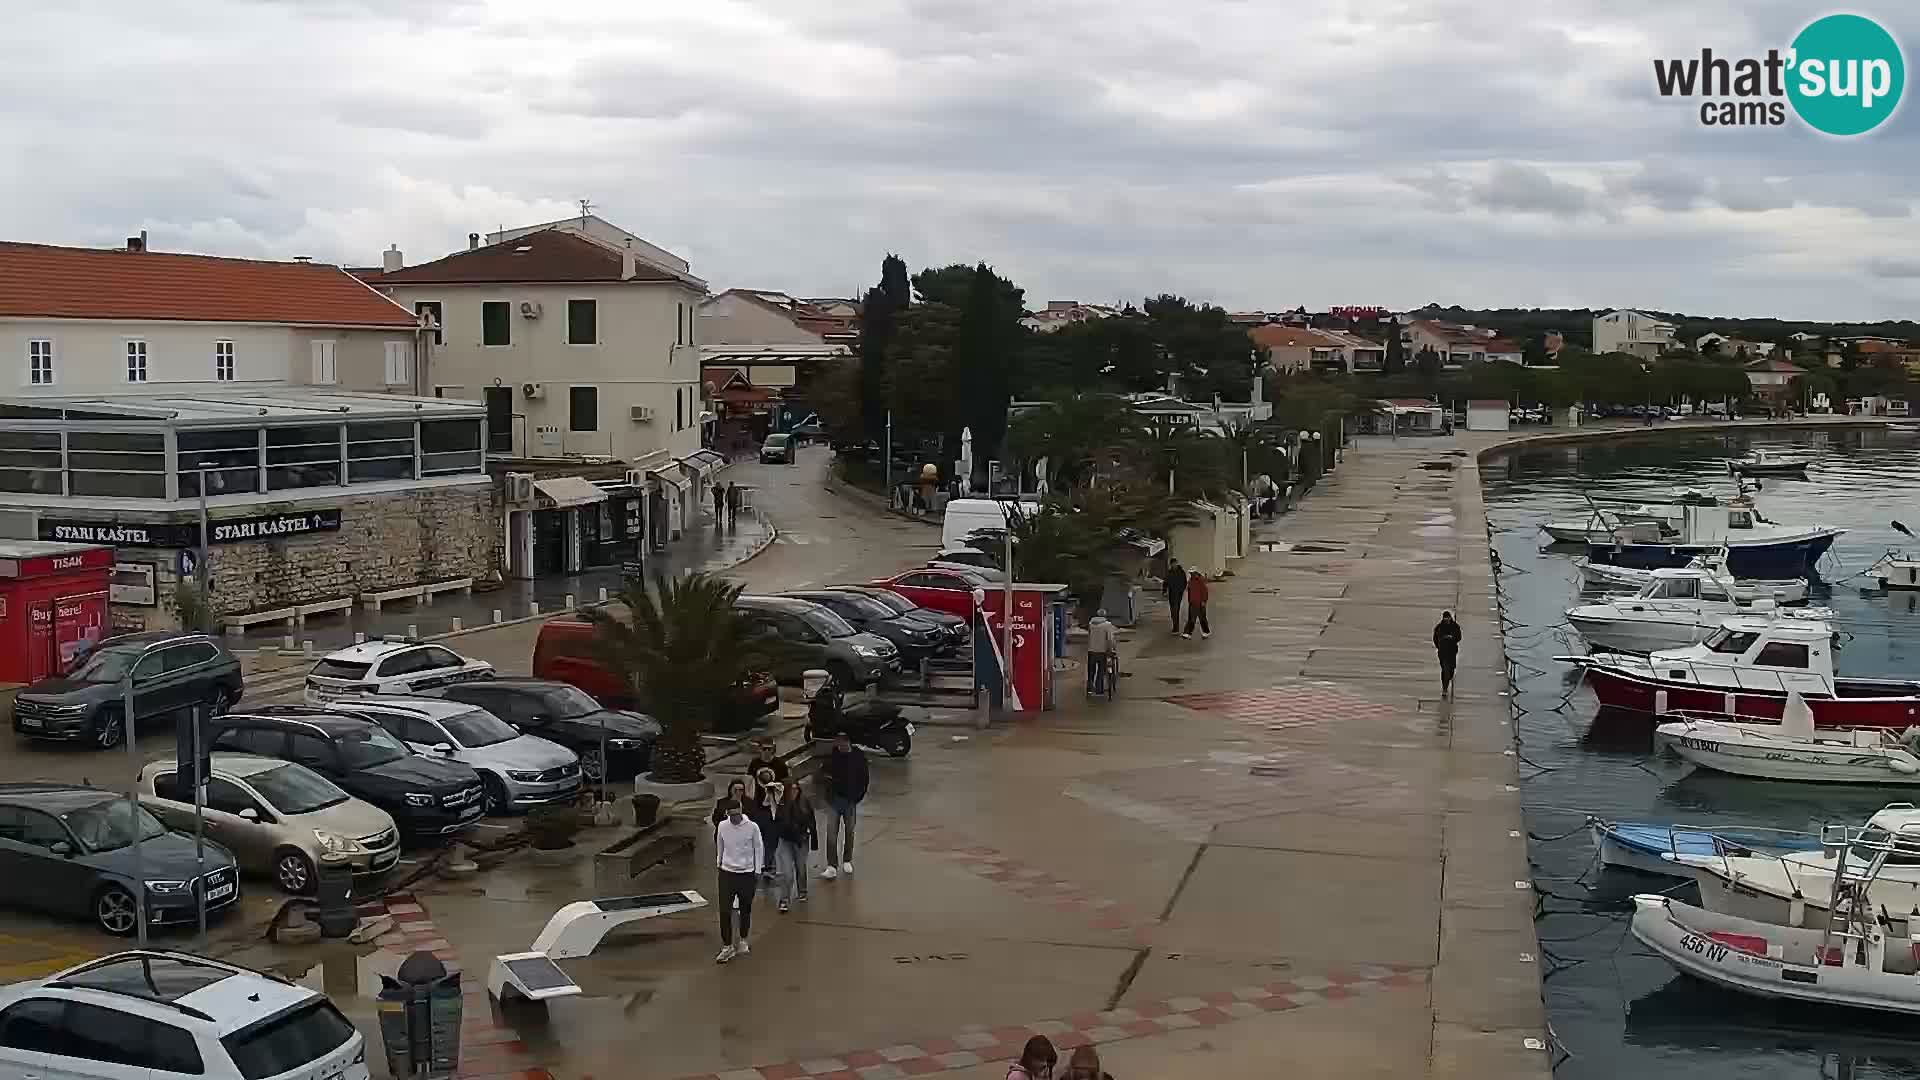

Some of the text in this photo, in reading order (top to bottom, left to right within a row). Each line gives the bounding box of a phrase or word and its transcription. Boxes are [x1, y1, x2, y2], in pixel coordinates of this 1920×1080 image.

[55, 526, 150, 543] STARI KAŠTEL
[215, 516, 310, 540] STARI KAŠTEL
[53, 555, 83, 569] TISAK
[33, 609, 52, 622] Buy
[1680, 934, 1705, 955] 456
[1706, 943, 1729, 962] NV
